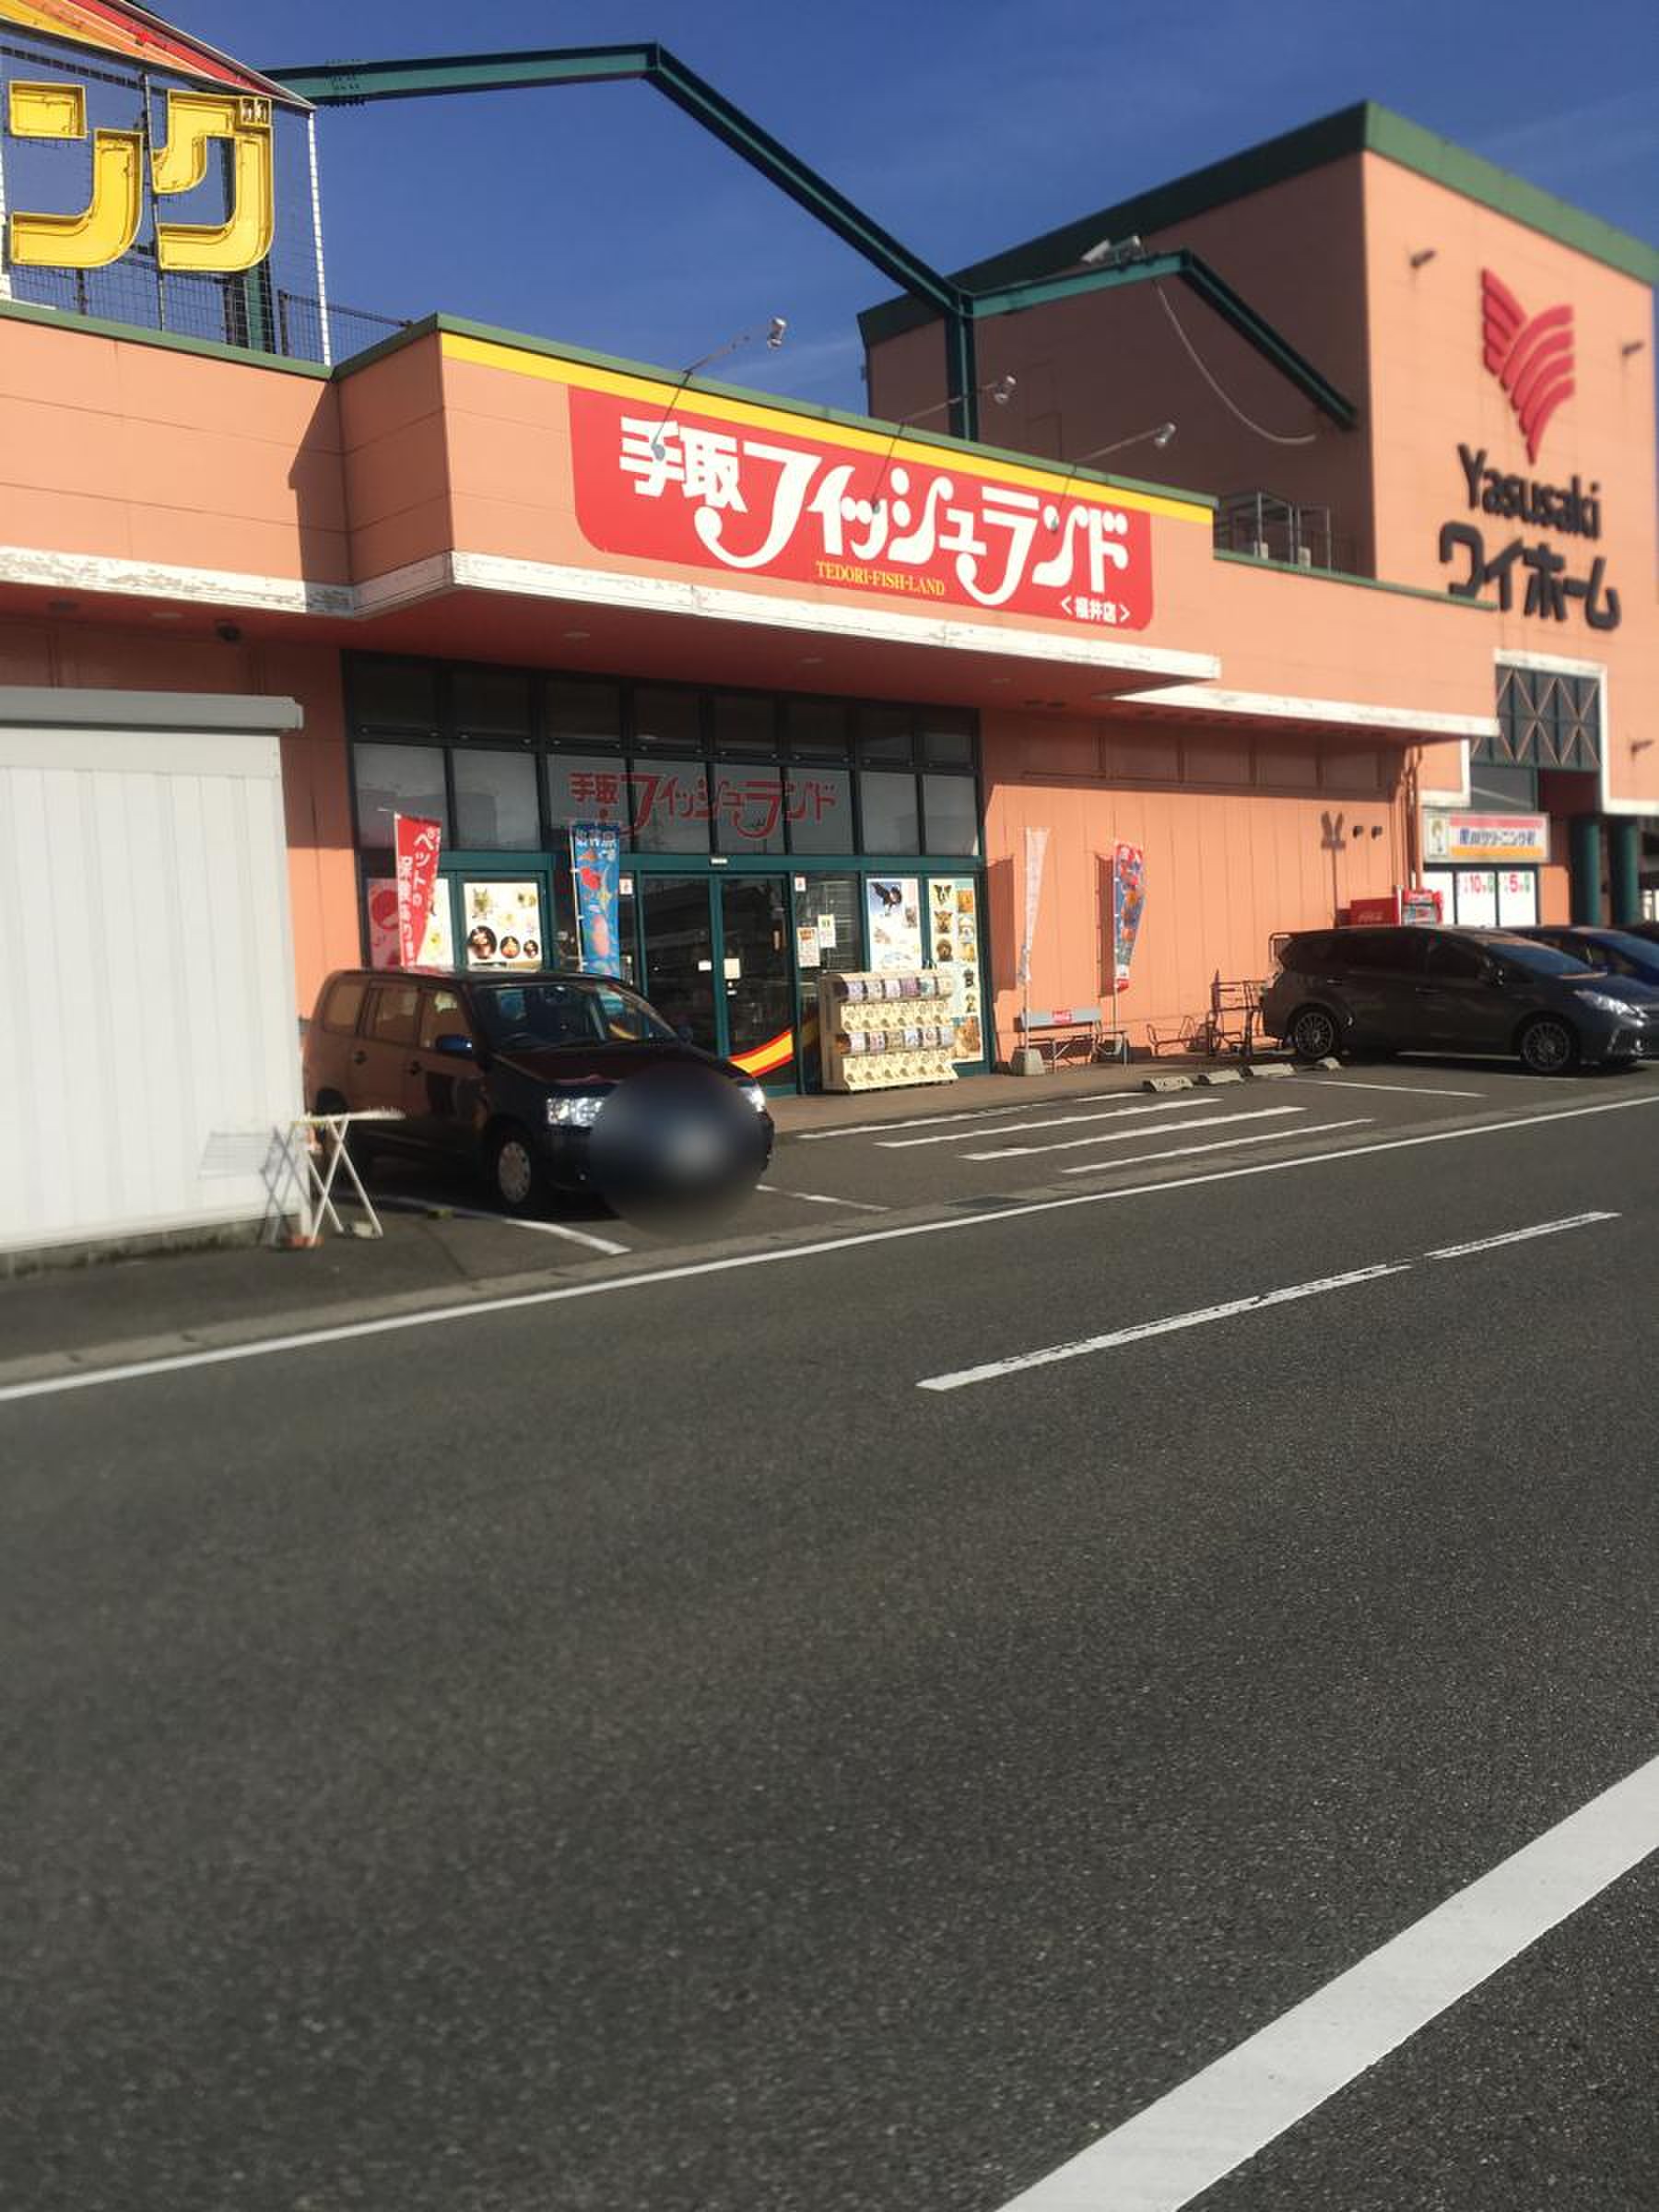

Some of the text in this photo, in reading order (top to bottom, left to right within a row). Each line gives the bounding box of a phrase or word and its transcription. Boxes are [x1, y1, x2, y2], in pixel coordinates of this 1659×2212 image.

[619, 415, 1129, 606] 手取フィッシュランド
[1457, 442, 1601, 541] Yasusaki
[1439, 520, 1621, 631] ワイホーム
